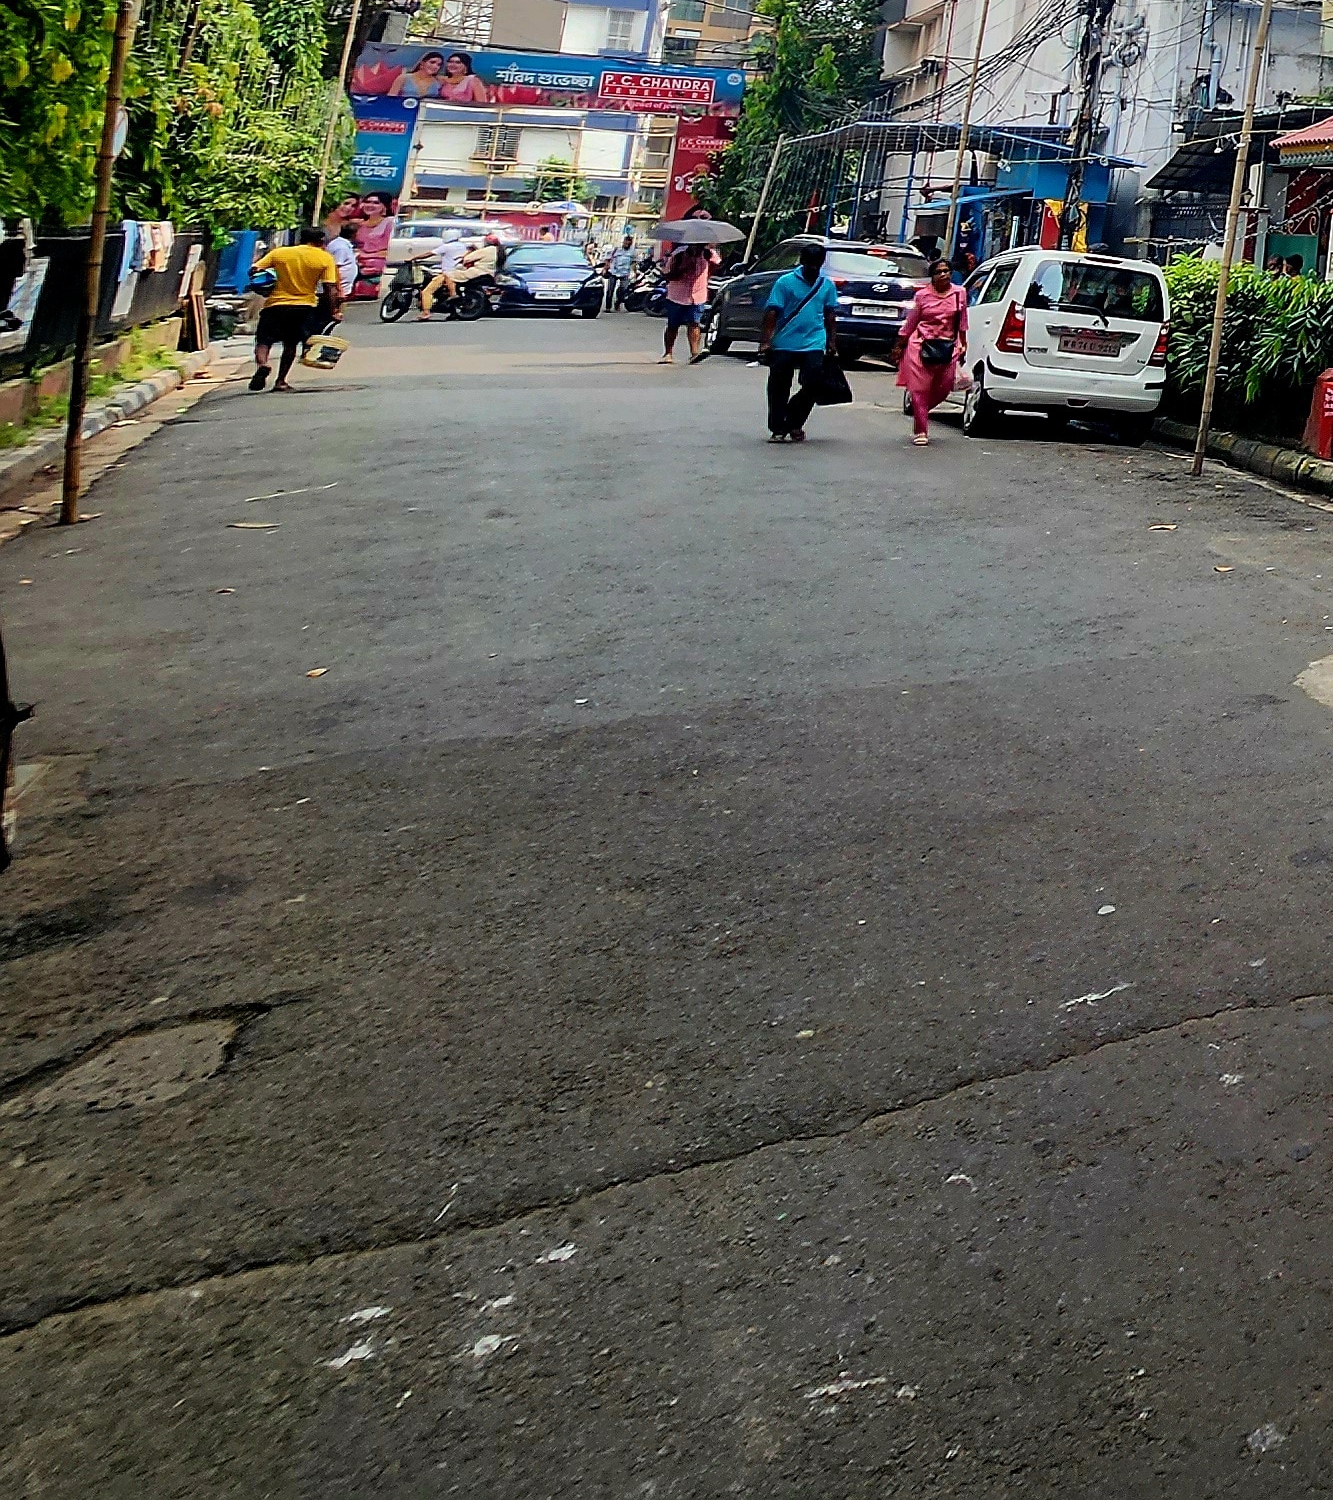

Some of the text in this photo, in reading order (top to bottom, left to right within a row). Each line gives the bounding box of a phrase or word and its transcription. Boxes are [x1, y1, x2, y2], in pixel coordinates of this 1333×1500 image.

[605, 74, 710, 91] P. C. CHANDRA
[603, 86, 710, 100] JEWELLRS
